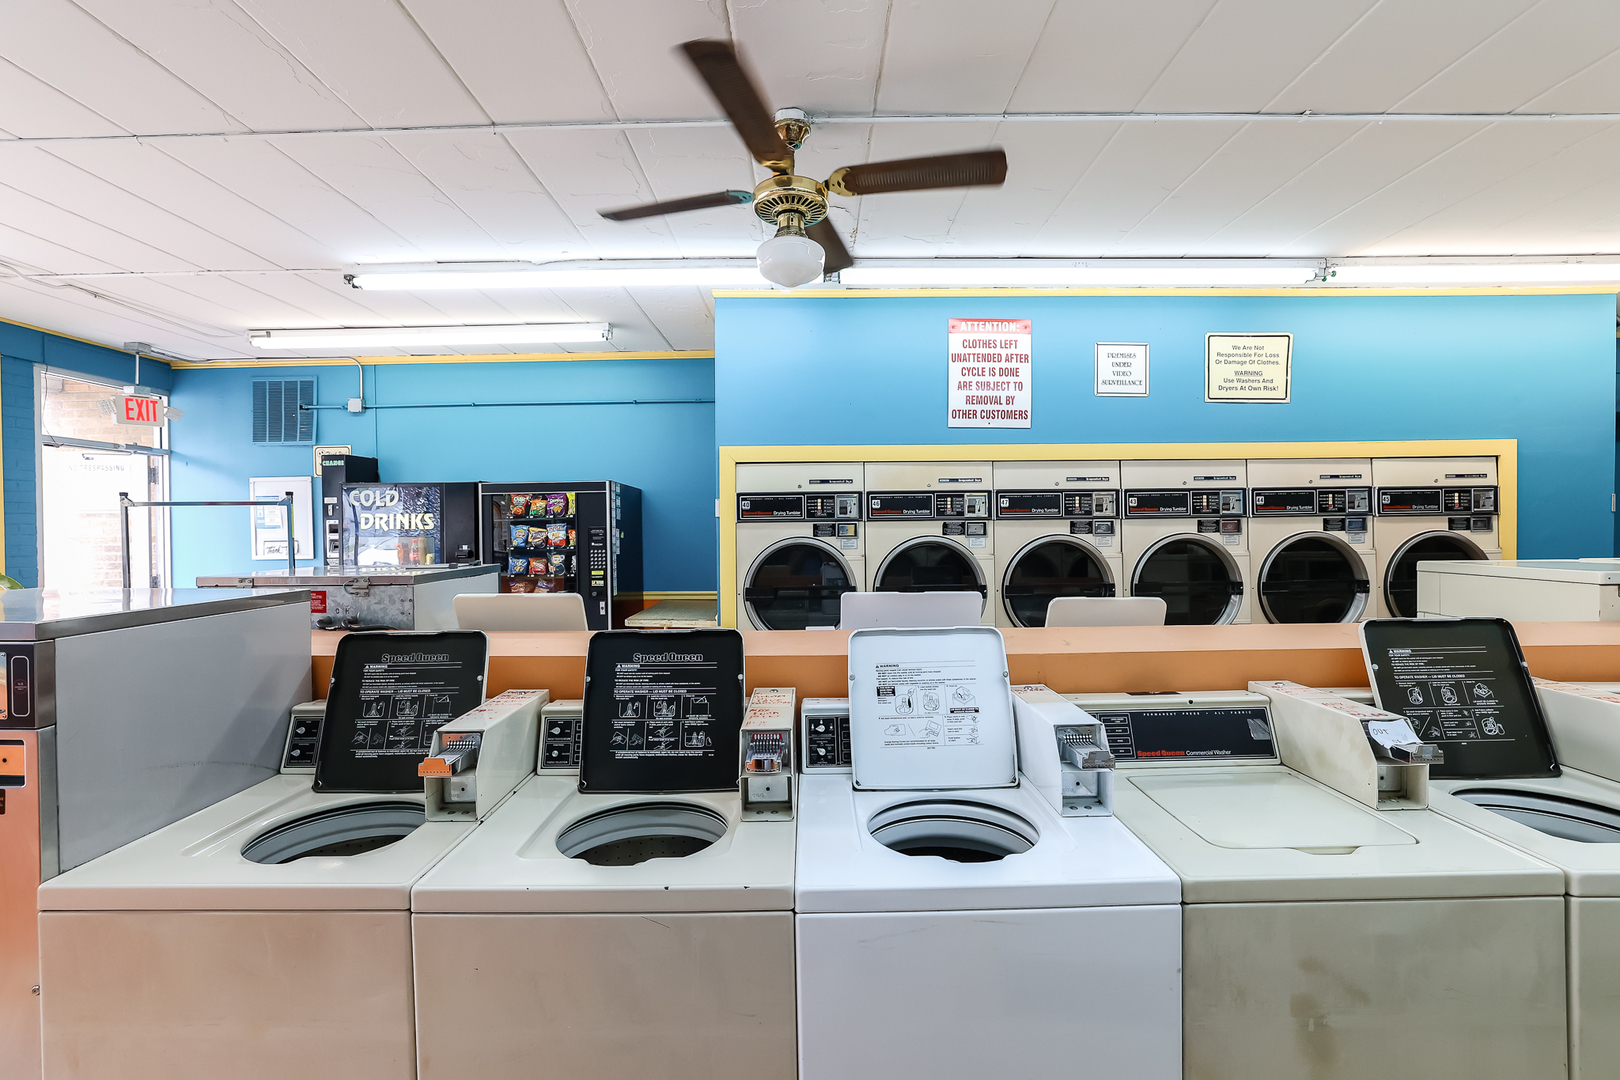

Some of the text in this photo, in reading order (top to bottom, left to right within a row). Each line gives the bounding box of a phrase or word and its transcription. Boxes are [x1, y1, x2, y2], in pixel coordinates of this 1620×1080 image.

[960, 321, 1020, 332] ATTENTION:
[962, 339, 1018, 349] CLOTHES LEFT
[951, 353, 1029, 363] UNATTENDED AFTER
[961, 367, 1019, 377] CYCLE IS DONE
[957, 381, 1024, 391] ARE SUBJECT TO
[965, 395, 1015, 405] REMOVAL BY
[124, 397, 158, 422] EXIT
[951, 409, 1029, 420] OTHER CUSTOMERS
[349, 490, 399, 507] COLD
[360, 513, 435, 531] DRINKS
[381, 653, 450, 664] Speed Queen
[632, 652, 704, 664] Speed Queen
